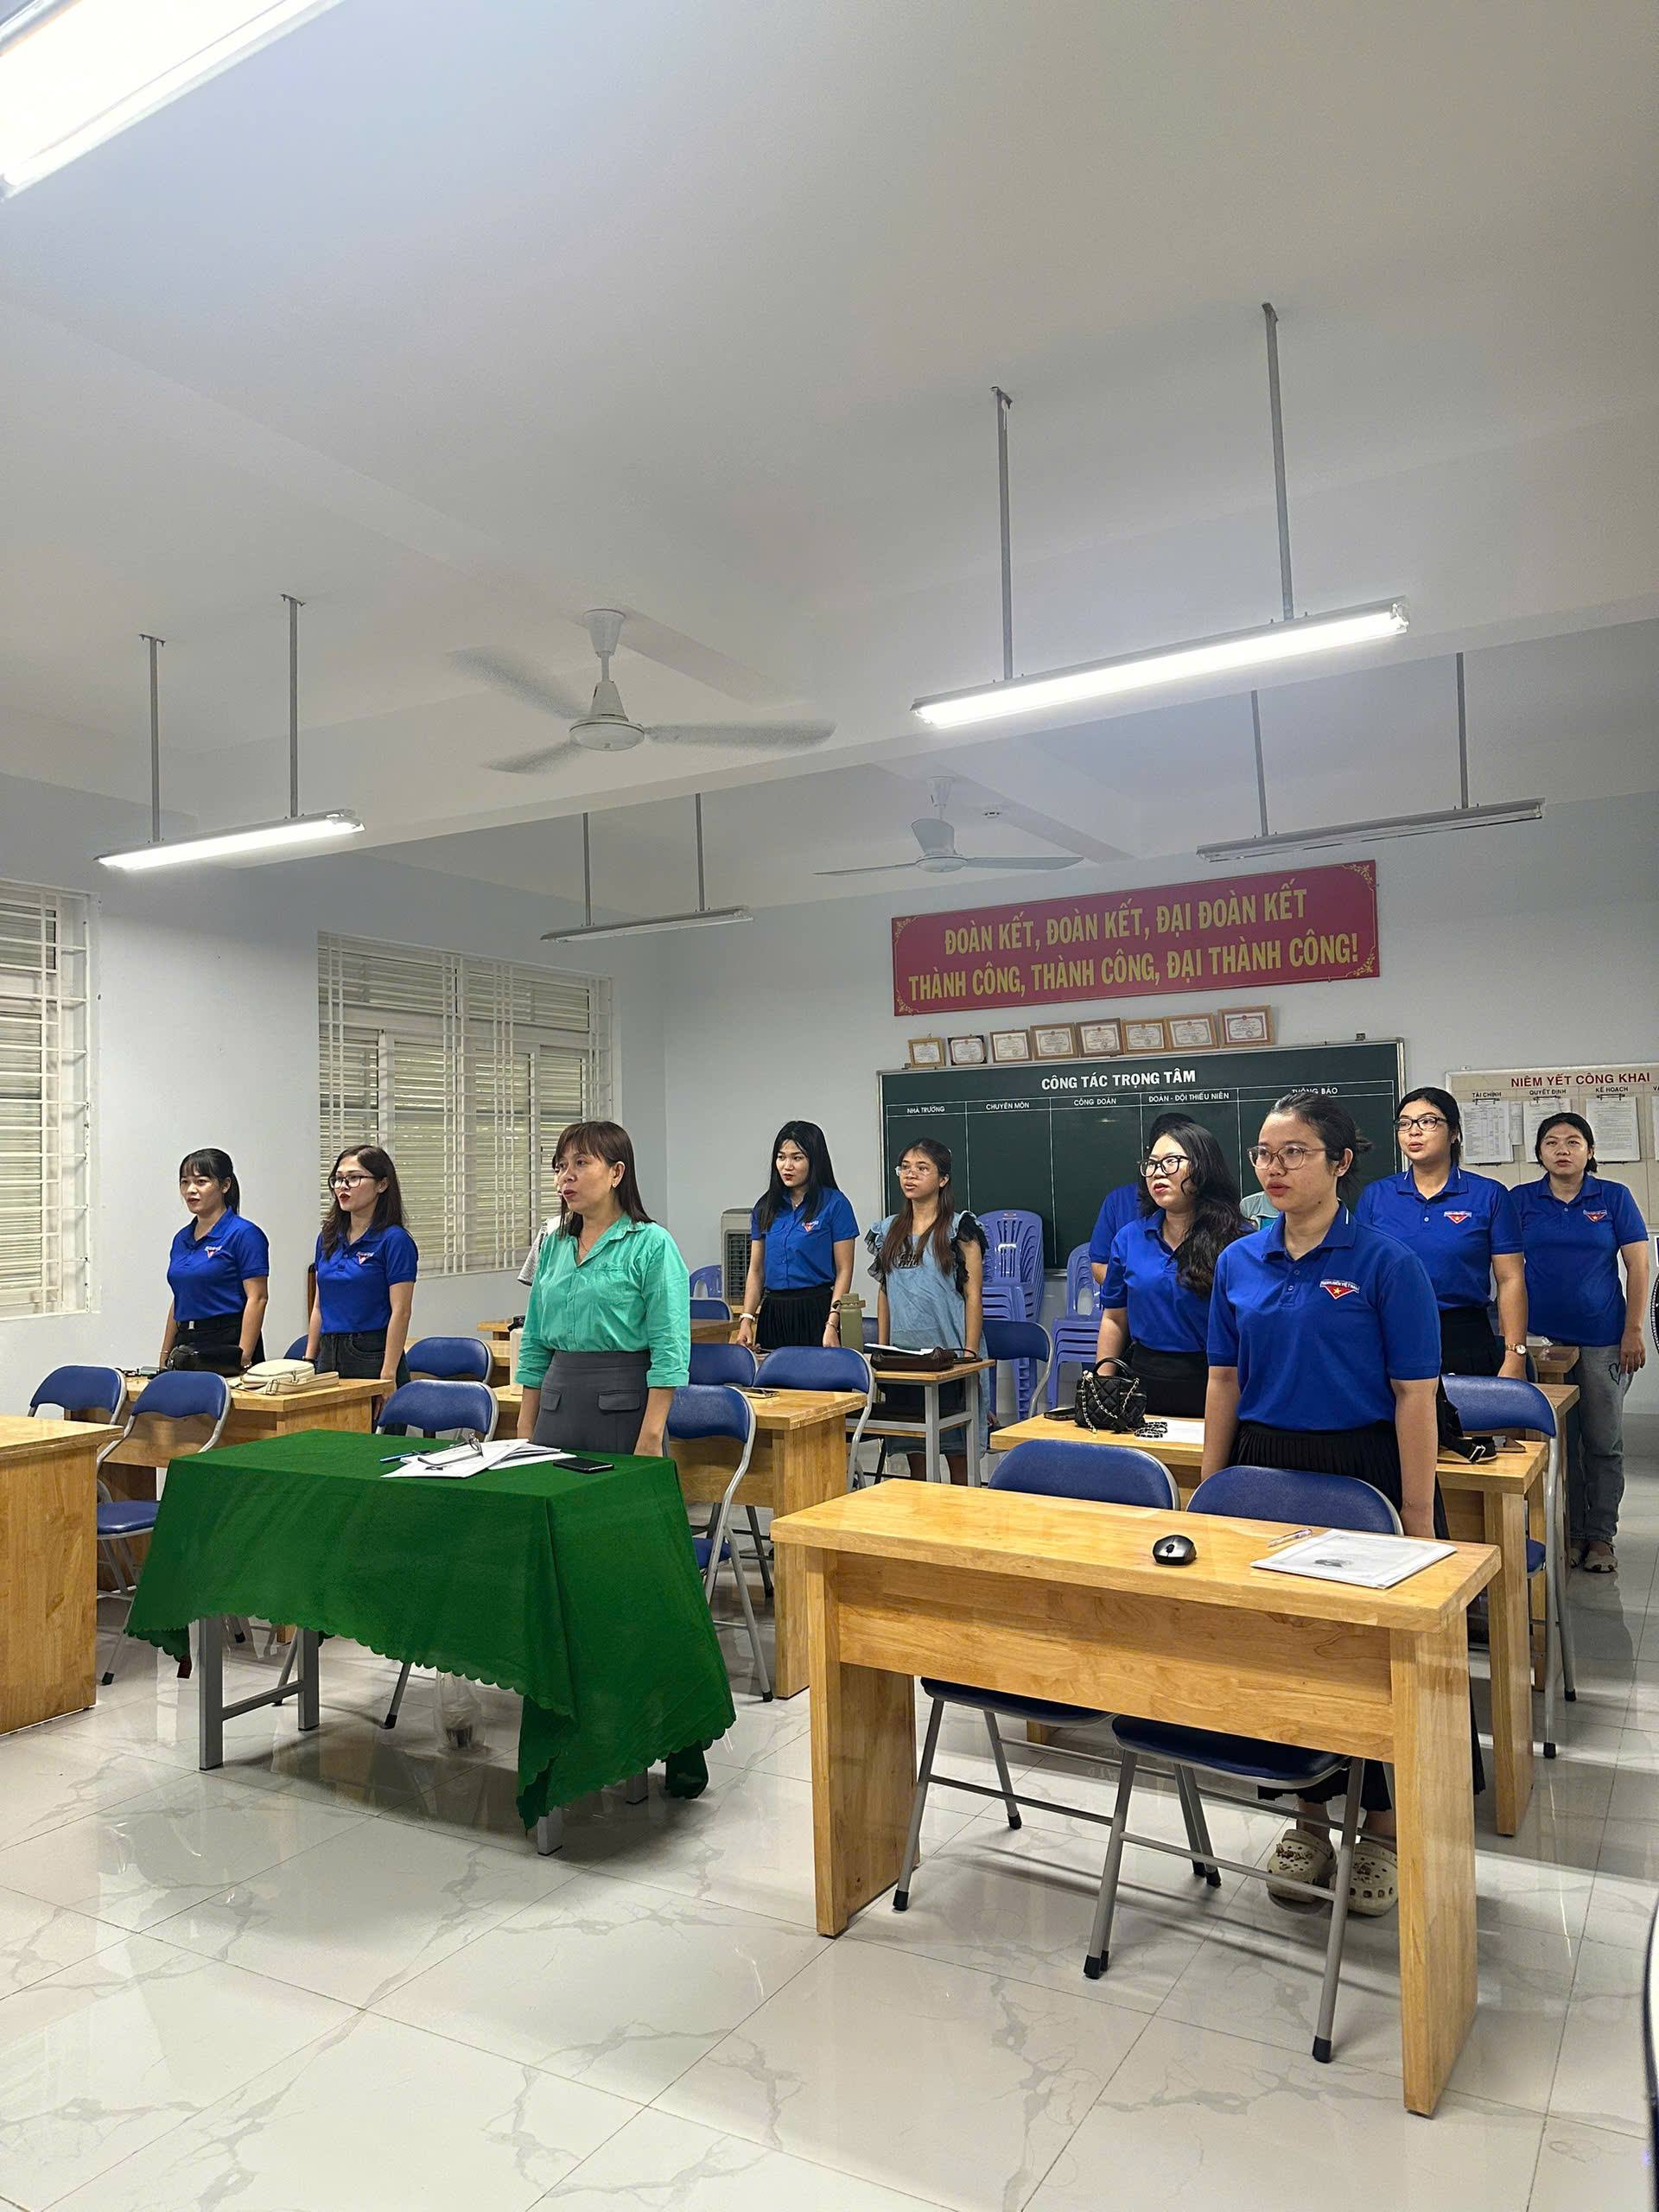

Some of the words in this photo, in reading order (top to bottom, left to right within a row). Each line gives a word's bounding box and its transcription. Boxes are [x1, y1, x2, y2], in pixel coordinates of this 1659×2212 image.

[944, 920, 993, 955] ĐOÀN
[998, 911, 1040, 953] KẾT,
[1046, 908, 1099, 945] ĐOÀN
[1104, 898, 1150, 940] KẾT,
[1156, 903, 1192, 938] ĐẠI
[1198, 890, 1256, 929] ĐOÀN
[1264, 878, 1307, 922] KẾT
[908, 967, 966, 1001] THÀNH
[972, 961, 1026, 997] CÔNG,
[1031, 955, 1095, 991] THÀNH
[1101, 949, 1161, 986] CÔNG,
[1166, 949, 1203, 983] ĐẠI
[1208, 936, 1281, 976] THÀNH
[1288, 928, 1358, 967] CÔNG!
[1041, 1075, 1077, 1090] CÔNG
[1081, 1071, 1108, 1088] TÁC
[1112, 1071, 1160, 1089] TRỌNG
[1163, 1067, 1196, 1083] TÂM
[1511, 1075, 1542, 1087] NIÊM
[1547, 1073, 1572, 1085] YẾT
[1576, 1072, 1614, 1084] CÔNG
[1618, 1072, 1649, 1084] KHAI
[1073, 1097, 1095, 1106] CÔNG
[1189, 1090, 1210, 1101] THIẾU
[1211, 1090, 1230, 1100] NIÊN
[986, 1102, 1014, 1110] CHUYÊN
[1014, 1101, 1030, 1109] MÔN
